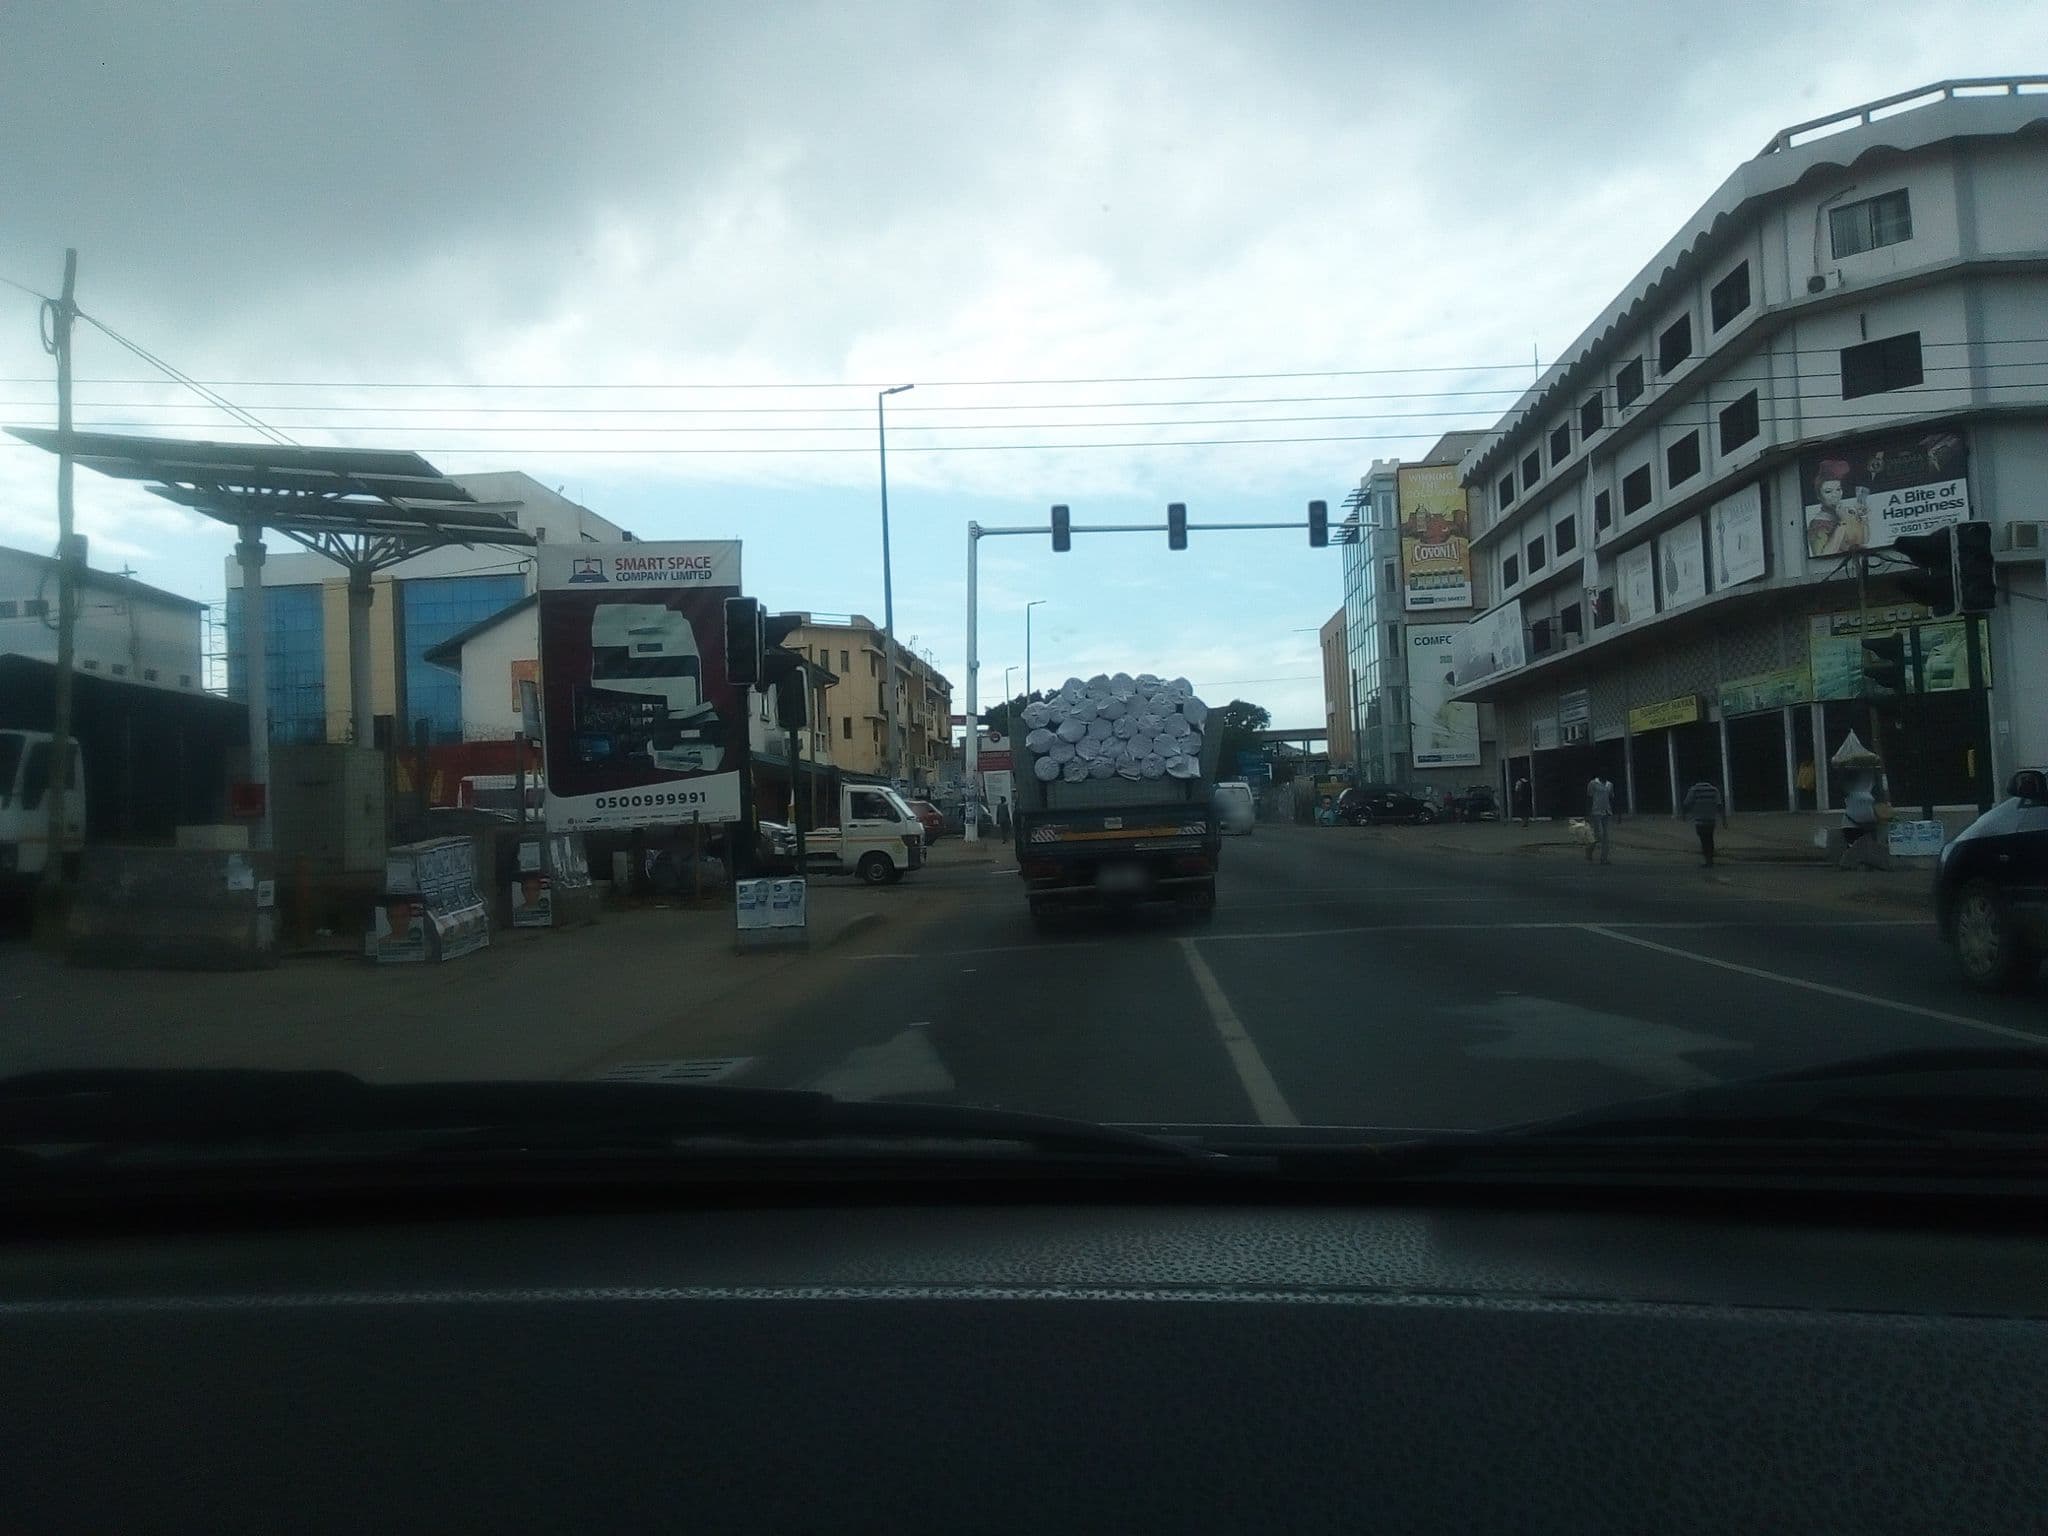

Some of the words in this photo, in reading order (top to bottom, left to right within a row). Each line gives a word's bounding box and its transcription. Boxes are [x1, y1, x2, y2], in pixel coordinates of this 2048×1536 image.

[1888, 494, 1901, 506] A
[1904, 489, 1936, 504] Bite
[1939, 482, 1957, 498] of
[1882, 498, 1965, 520] Happiness
[1414, 543, 1458, 561] COVONIA
[615, 557, 665, 571] SMART
[668, 556, 712, 570] SPACE
[615, 571, 668, 582] COMPANY
[670, 570, 712, 581] LIMITED
[595, 791, 706, 809] 0500999991
